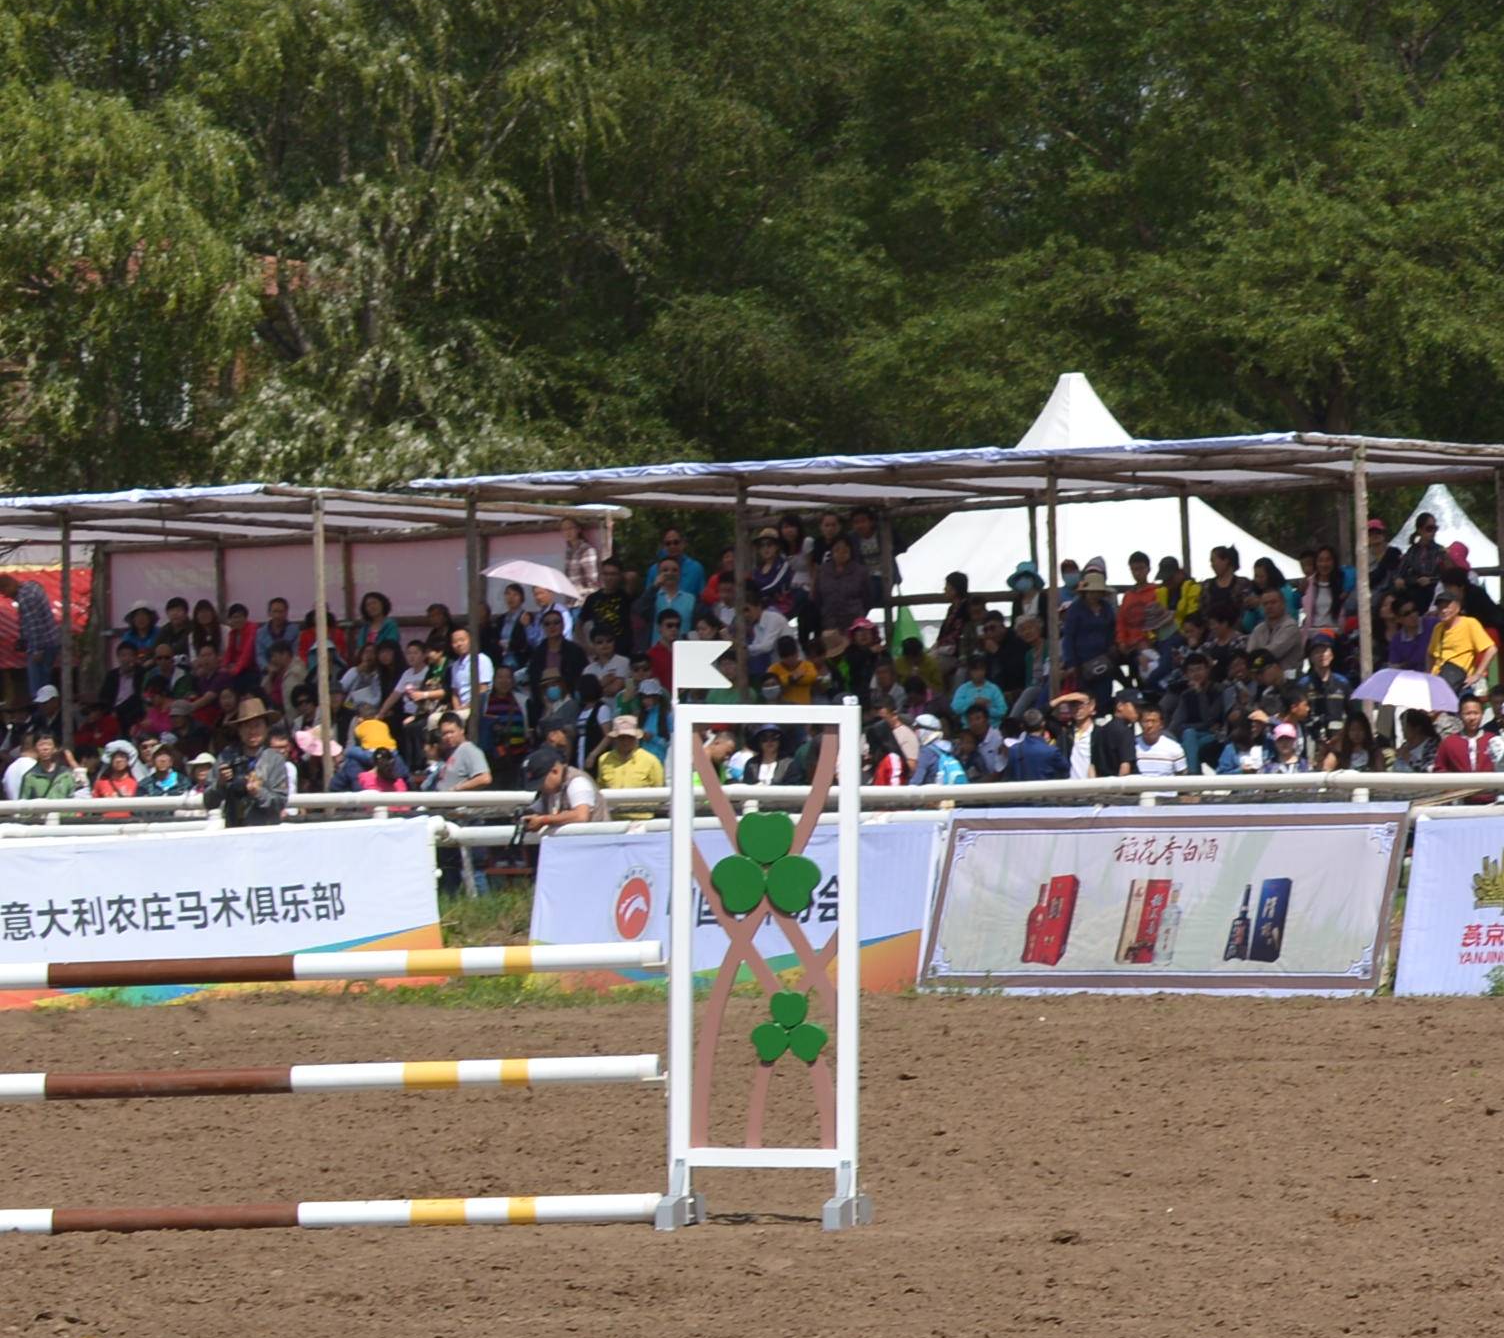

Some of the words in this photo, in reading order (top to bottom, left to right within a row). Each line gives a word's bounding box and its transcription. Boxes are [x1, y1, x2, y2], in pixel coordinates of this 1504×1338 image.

[1, 881, 345, 941] 意大利农庄马术俱乐部
